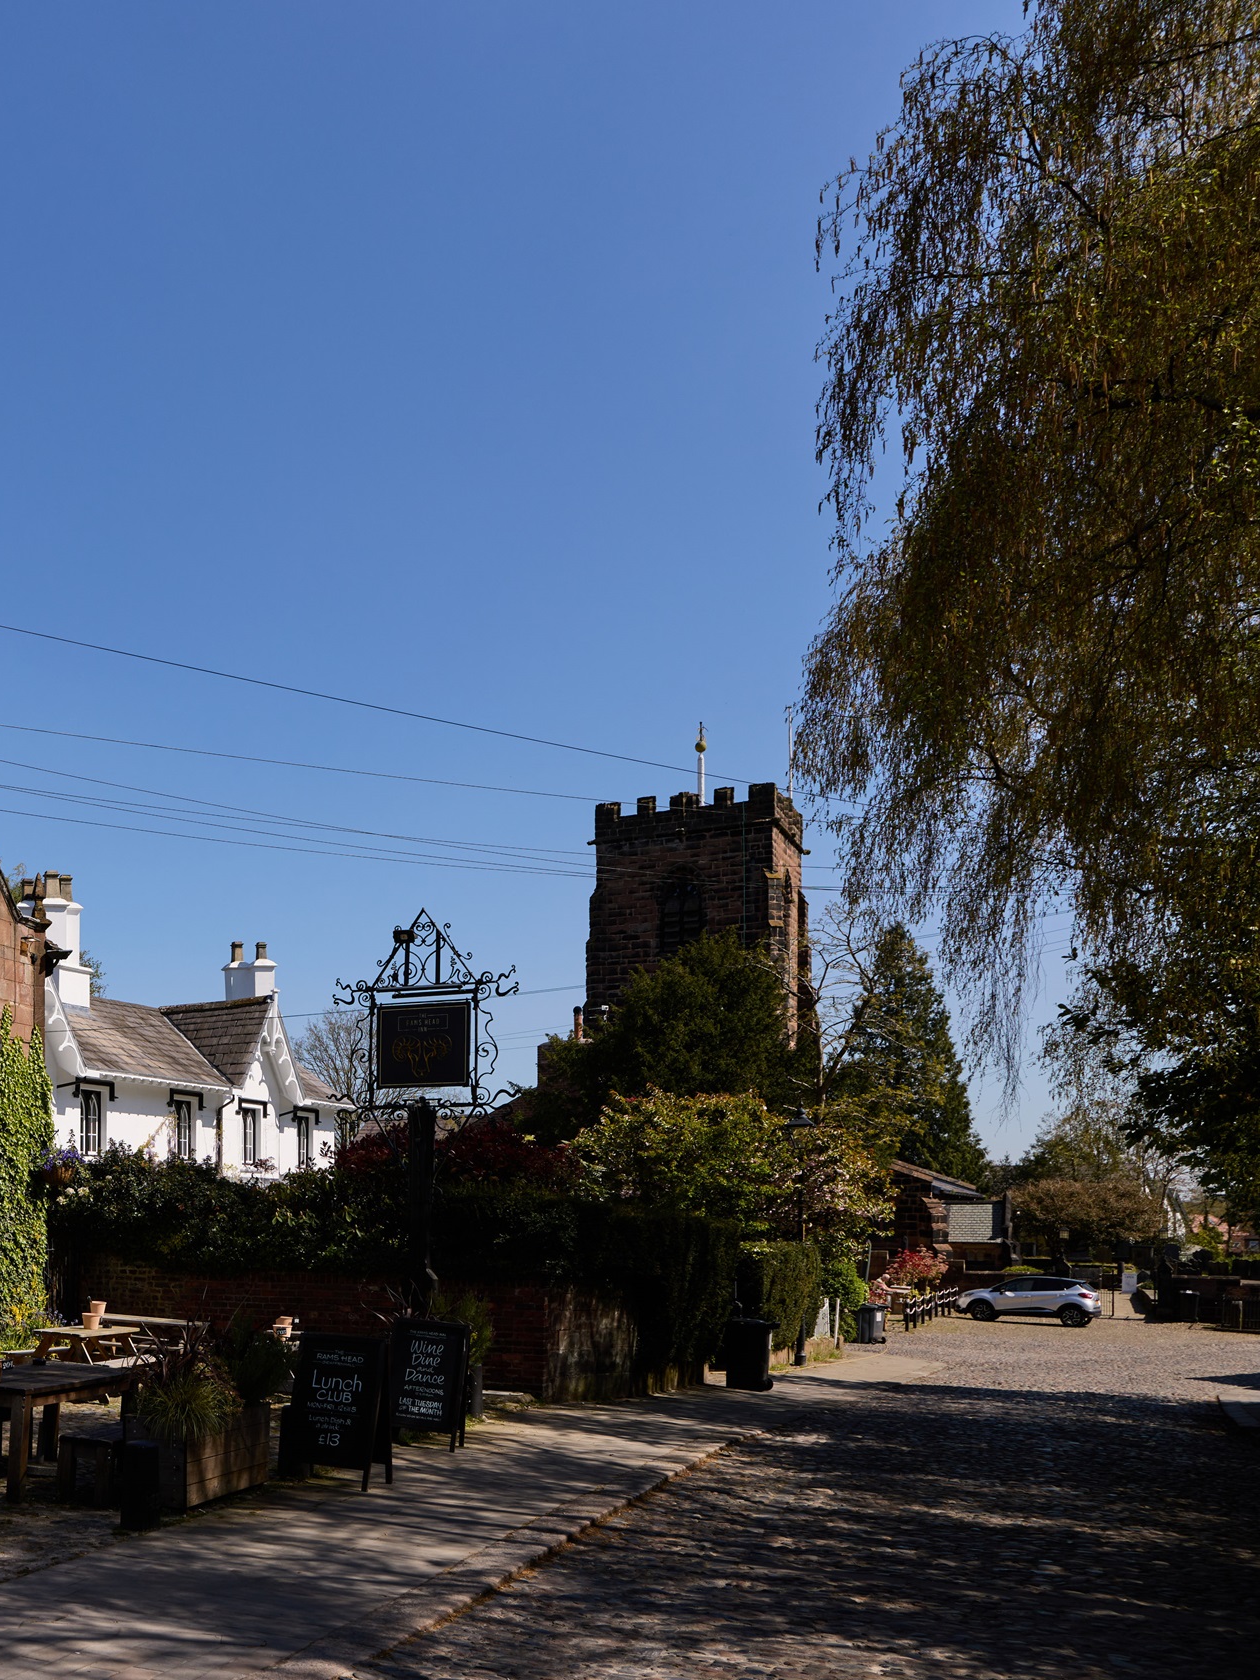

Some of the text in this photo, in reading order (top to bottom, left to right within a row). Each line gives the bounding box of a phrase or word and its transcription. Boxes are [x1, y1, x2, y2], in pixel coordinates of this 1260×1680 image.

[410, 1340, 444, 1355] Wine
[412, 1353, 440, 1367] Dine
[312, 1369, 362, 1392] Lunch
[405, 1368, 444, 1385] Dance
[317, 1390, 352, 1403] CLUB
[404, 1384, 444, 1396] AFTERNOONS
[399, 1397, 442, 1410] LAST TUESDAY
[420, 1407, 442, 1416] MONTH
[318, 1433, 340, 1446] £13
